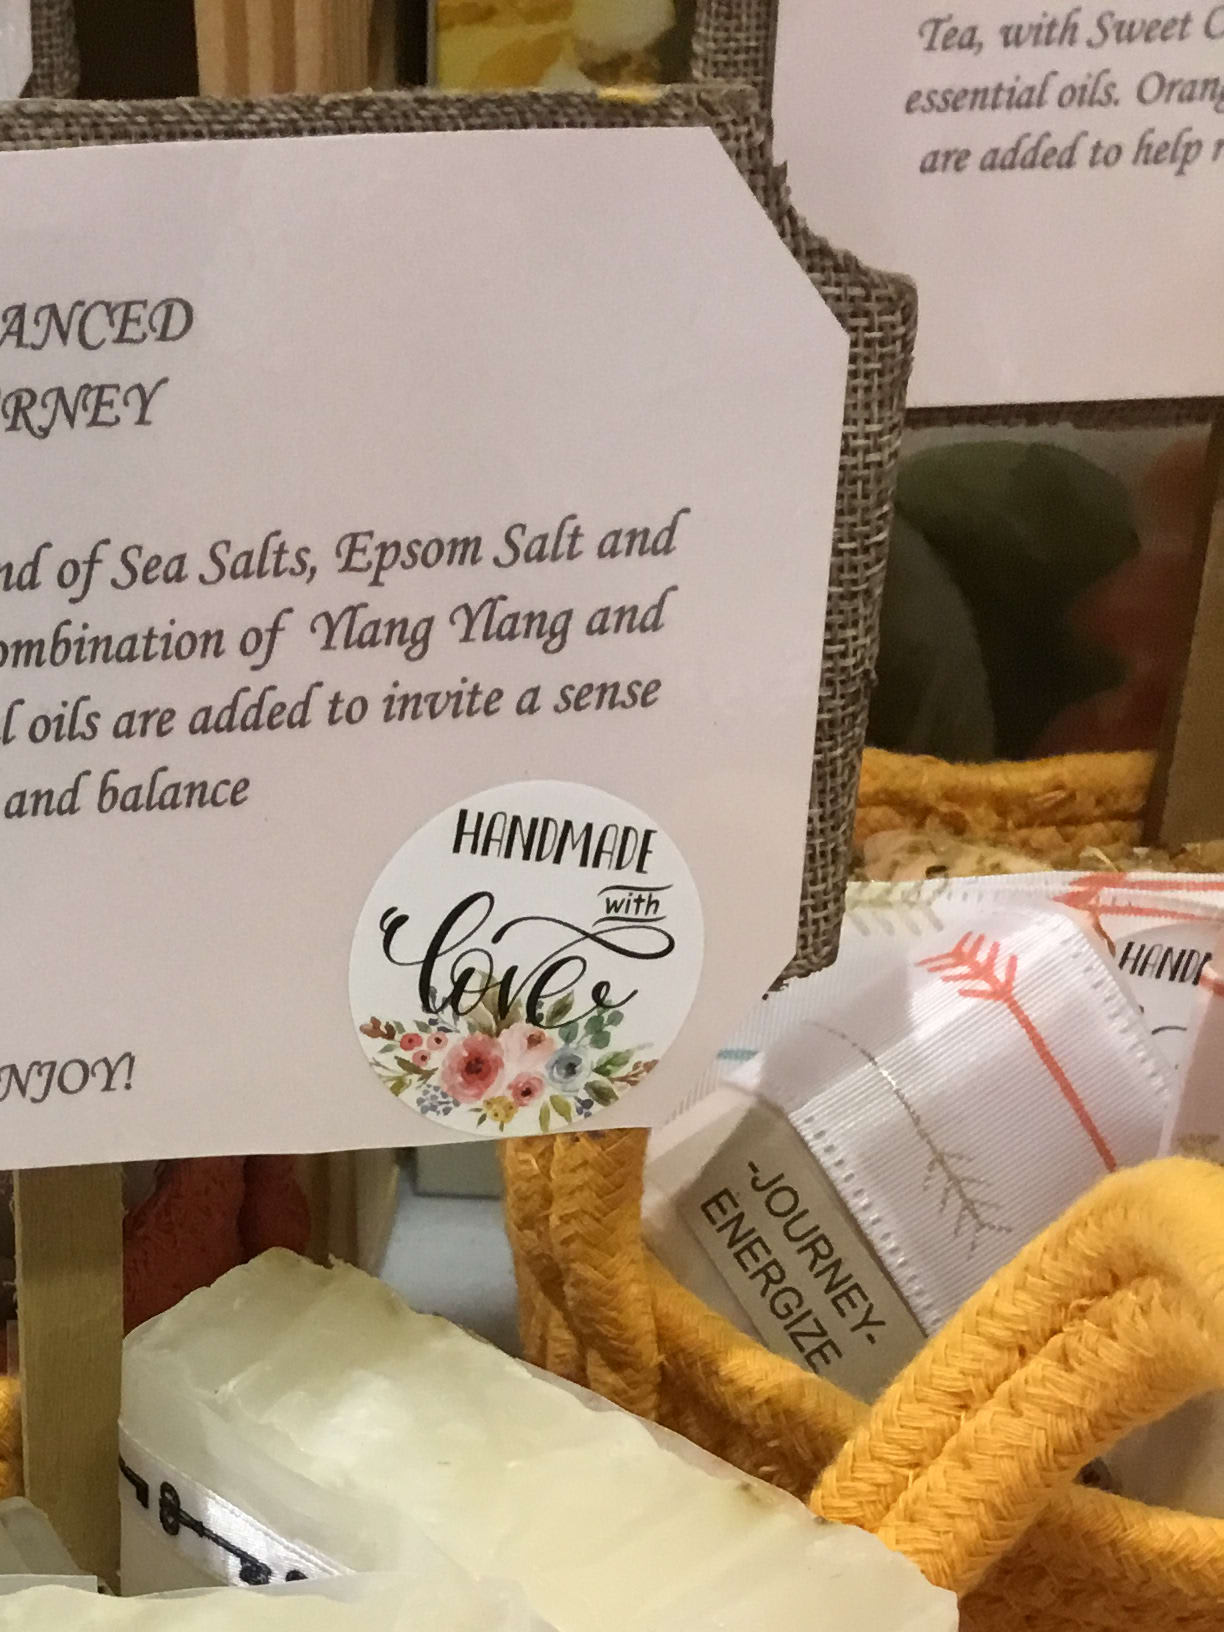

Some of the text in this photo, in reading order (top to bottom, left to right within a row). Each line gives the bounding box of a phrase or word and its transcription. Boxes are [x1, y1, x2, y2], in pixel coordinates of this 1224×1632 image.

[918, 13, 983, 56] Tea,
[998, 6, 1082, 49] with
[1085, 10, 1193, 50] Sweet
[904, 70, 1059, 115] essential
[1057, 68, 1120, 109] oils.
[919, 147, 972, 175] are
[978, 130, 1089, 173] added
[1088, 138, 1123, 168] to
[1131, 126, 1203, 177] help
[57, 538, 111, 605] of
[111, 544, 188, 592] Sea
[198, 530, 319, 588] Salts,
[335, 530, 483, 587] Epsom
[492, 513, 584, 568] Salt
[596, 507, 691, 559] and
[239, 607, 294, 672] of
[310, 602, 435, 662] Ylang
[449, 594, 574, 654] Ylang
[585, 585, 679, 636] and
[27, 695, 99, 744] oils
[112, 707, 176, 740] are
[188, 681, 324, 735] added
[327, 688, 369, 726] to
[382, 676, 504, 723] invite
[515, 689, 541, 717] a
[552, 676, 662, 715] sense
[4, 770, 93, 820] and
[97, 766, 251, 814] balance
[452, 808, 658, 875] HANDMADE
[605, 892, 660, 916] with
[700, 1187, 844, 1375] ENERGIZE
[748, 1160, 886, 1345] -JOURNEY-
